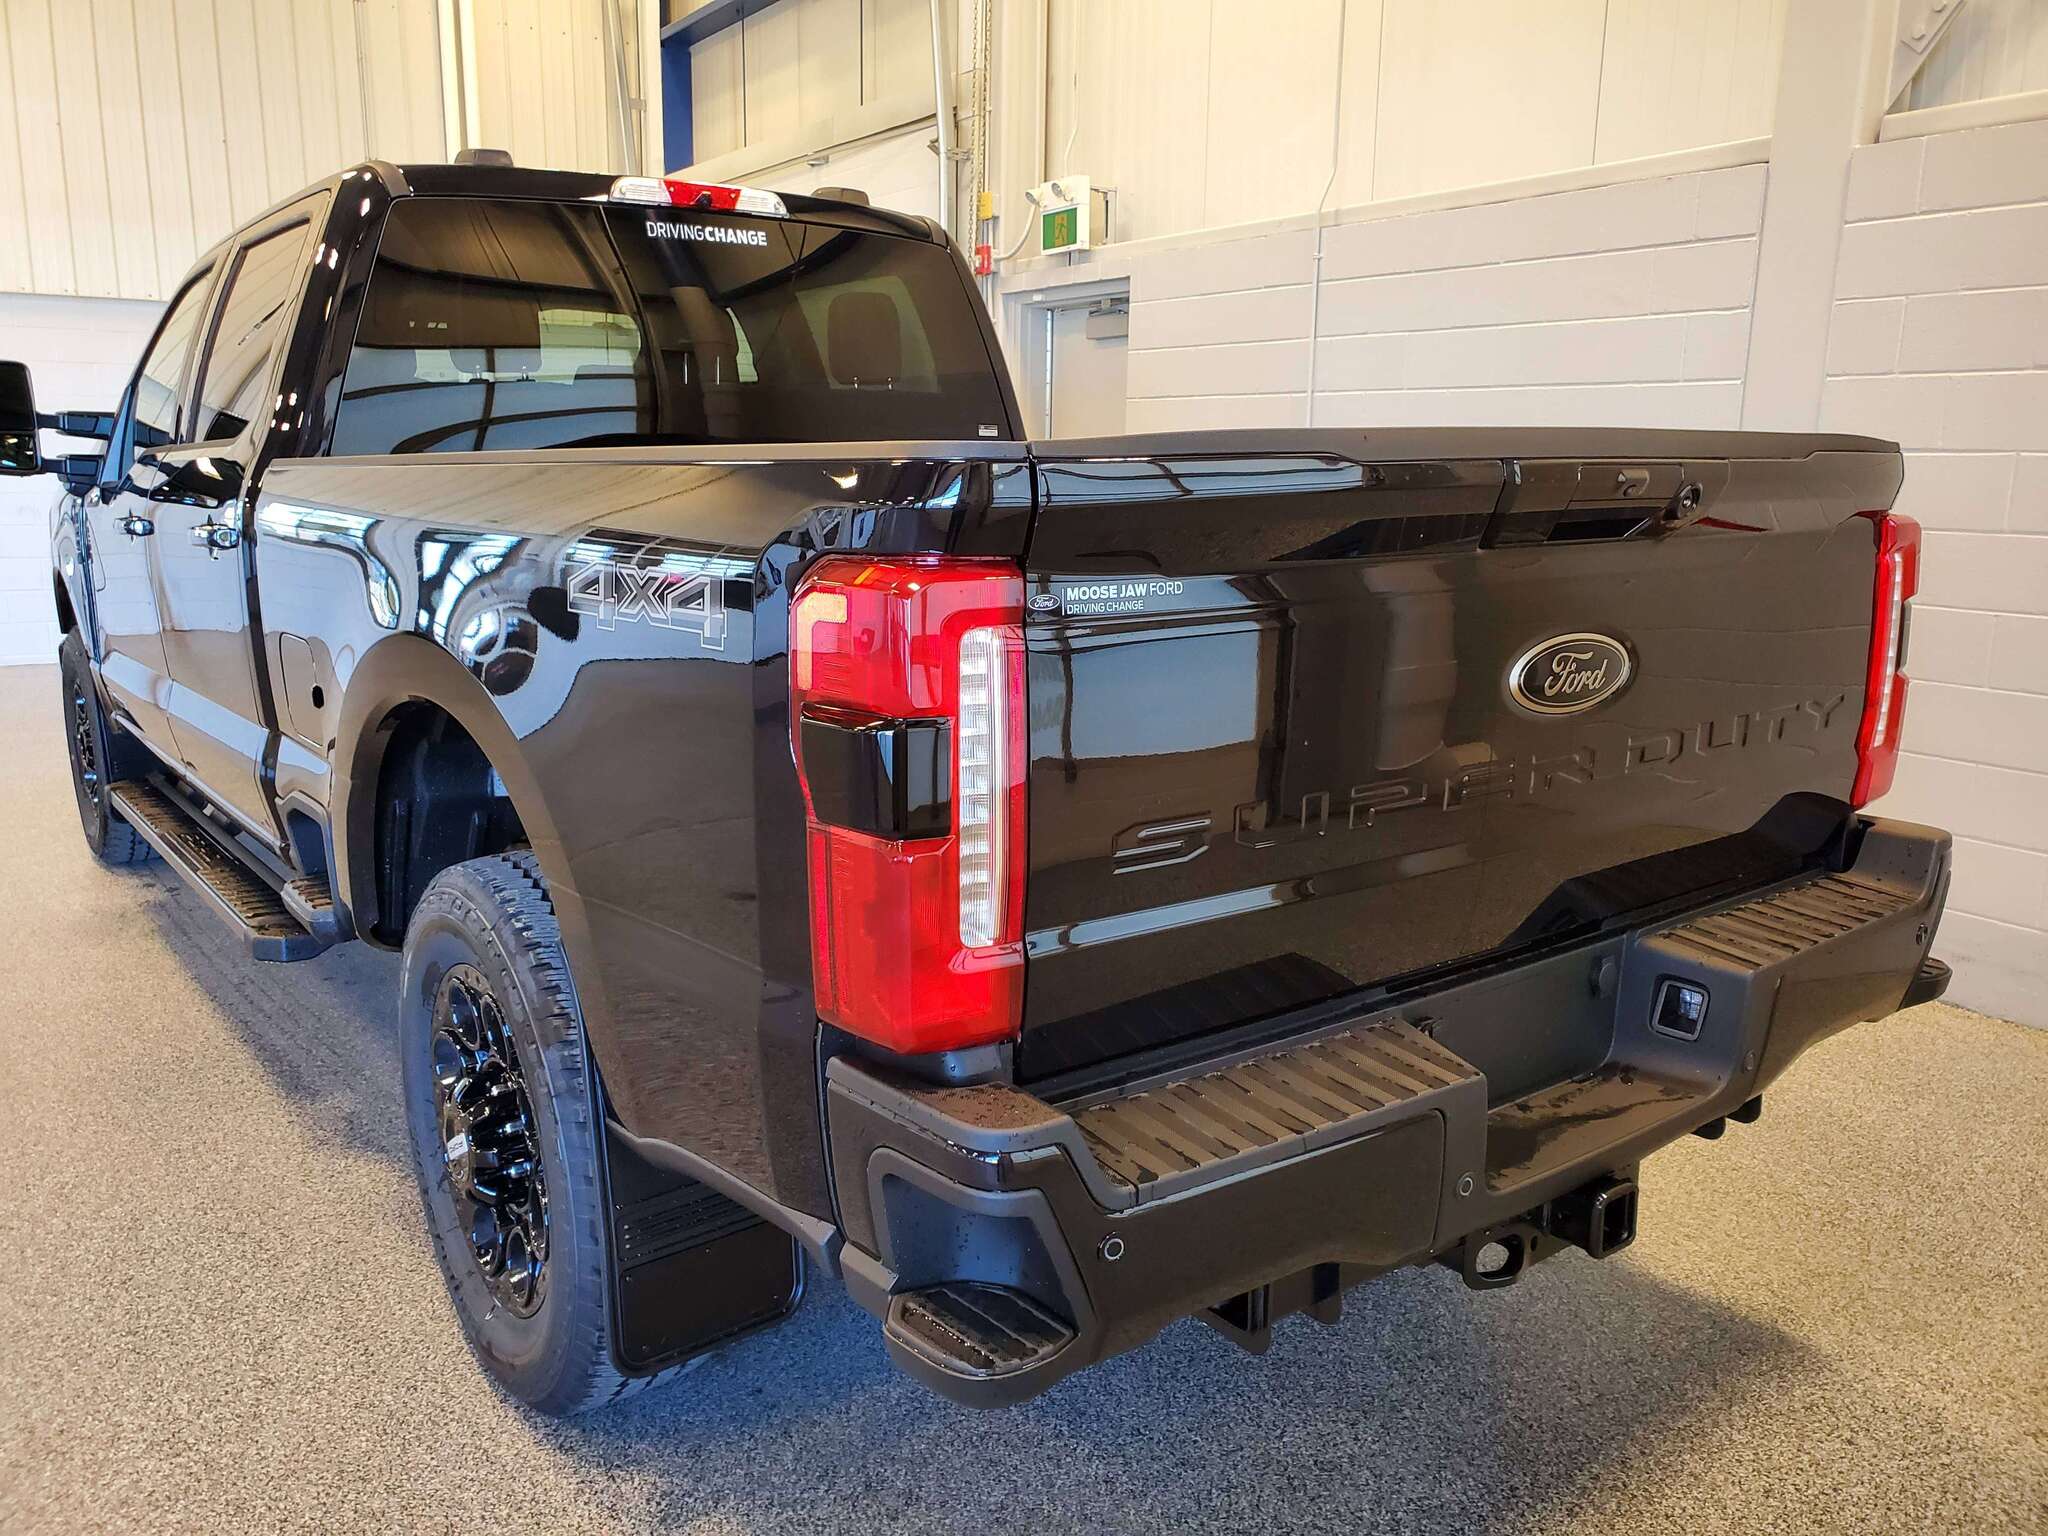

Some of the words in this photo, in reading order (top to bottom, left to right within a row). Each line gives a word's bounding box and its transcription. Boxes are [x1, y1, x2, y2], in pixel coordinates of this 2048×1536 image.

[1066, 585, 1118, 601] MOOSE
[1119, 583, 1148, 598] JAW
[1149, 581, 1184, 596] FORD
[1066, 602, 1105, 615] DRIVING
[1106, 600, 1144, 613] CHANGE
[1112, 744, 1595, 875] SUPER
[1624, 693, 1847, 775] DUTY
